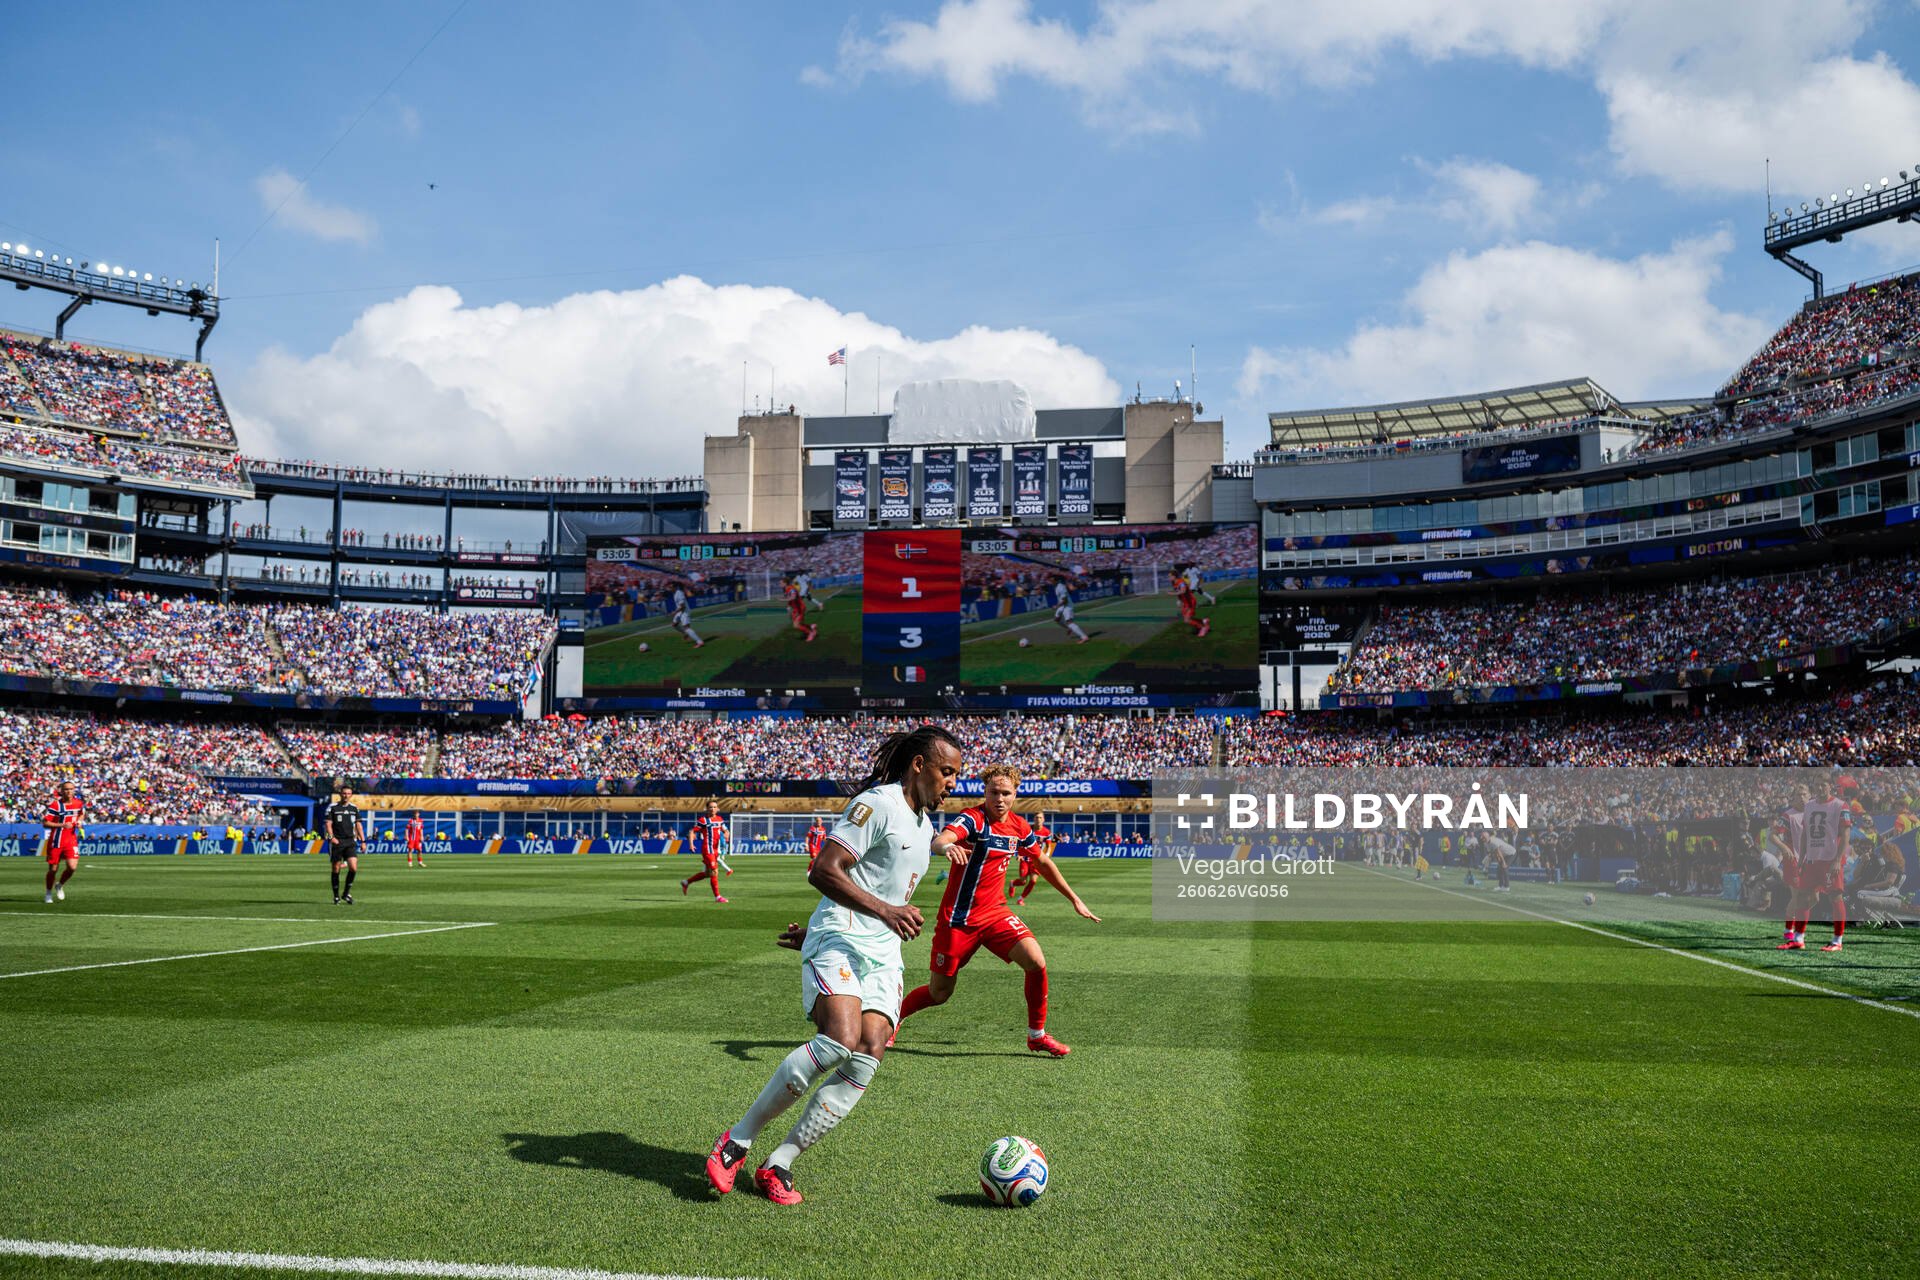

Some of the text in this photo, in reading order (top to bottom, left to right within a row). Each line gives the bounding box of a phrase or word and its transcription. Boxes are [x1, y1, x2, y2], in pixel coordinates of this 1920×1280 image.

[1688, 492, 1740, 511] BOTON
[28, 509, 82, 524] BOON
[1422, 529, 1472, 540] #FIFAWorldCup
[978, 541, 1008, 551] 53:05
[1101, 540, 1115, 548] FRA
[1689, 538, 1742, 556] BOSTON
[602, 550, 631, 559] 53:05
[1423, 570, 1472, 581] #FIFAWorldCup
[474, 589, 494, 598] 2021
[902, 577, 922, 598] 1
[900, 628, 923, 648] 3
[1777, 655, 1815, 672] BOON
[696, 688, 746, 696] Hisense
[1082, 684, 1134, 694] Hisense
[1027, 696, 1148, 706] FIFA WORLD CUP 2026
[477, 783, 529, 792] #FIFAWorldCup
[726, 782, 781, 793] BOSTON
[1017, 782, 1092, 793] CUP 2026
[78, 841, 96, 856] tap
[96, 840, 106, 854] in
[108, 840, 131, 854] with
[133, 842, 154, 854] VISA
[198, 840, 221, 854] VISA
[252, 841, 280, 854] VISA
[423, 841, 452, 853] VISA
[516, 840, 555, 854] VISA
[607, 840, 644, 854] VISA
[752, 841, 778, 852] with
[784, 842, 807, 853] VIS
[1087, 844, 1197, 858] tap in with VISA
